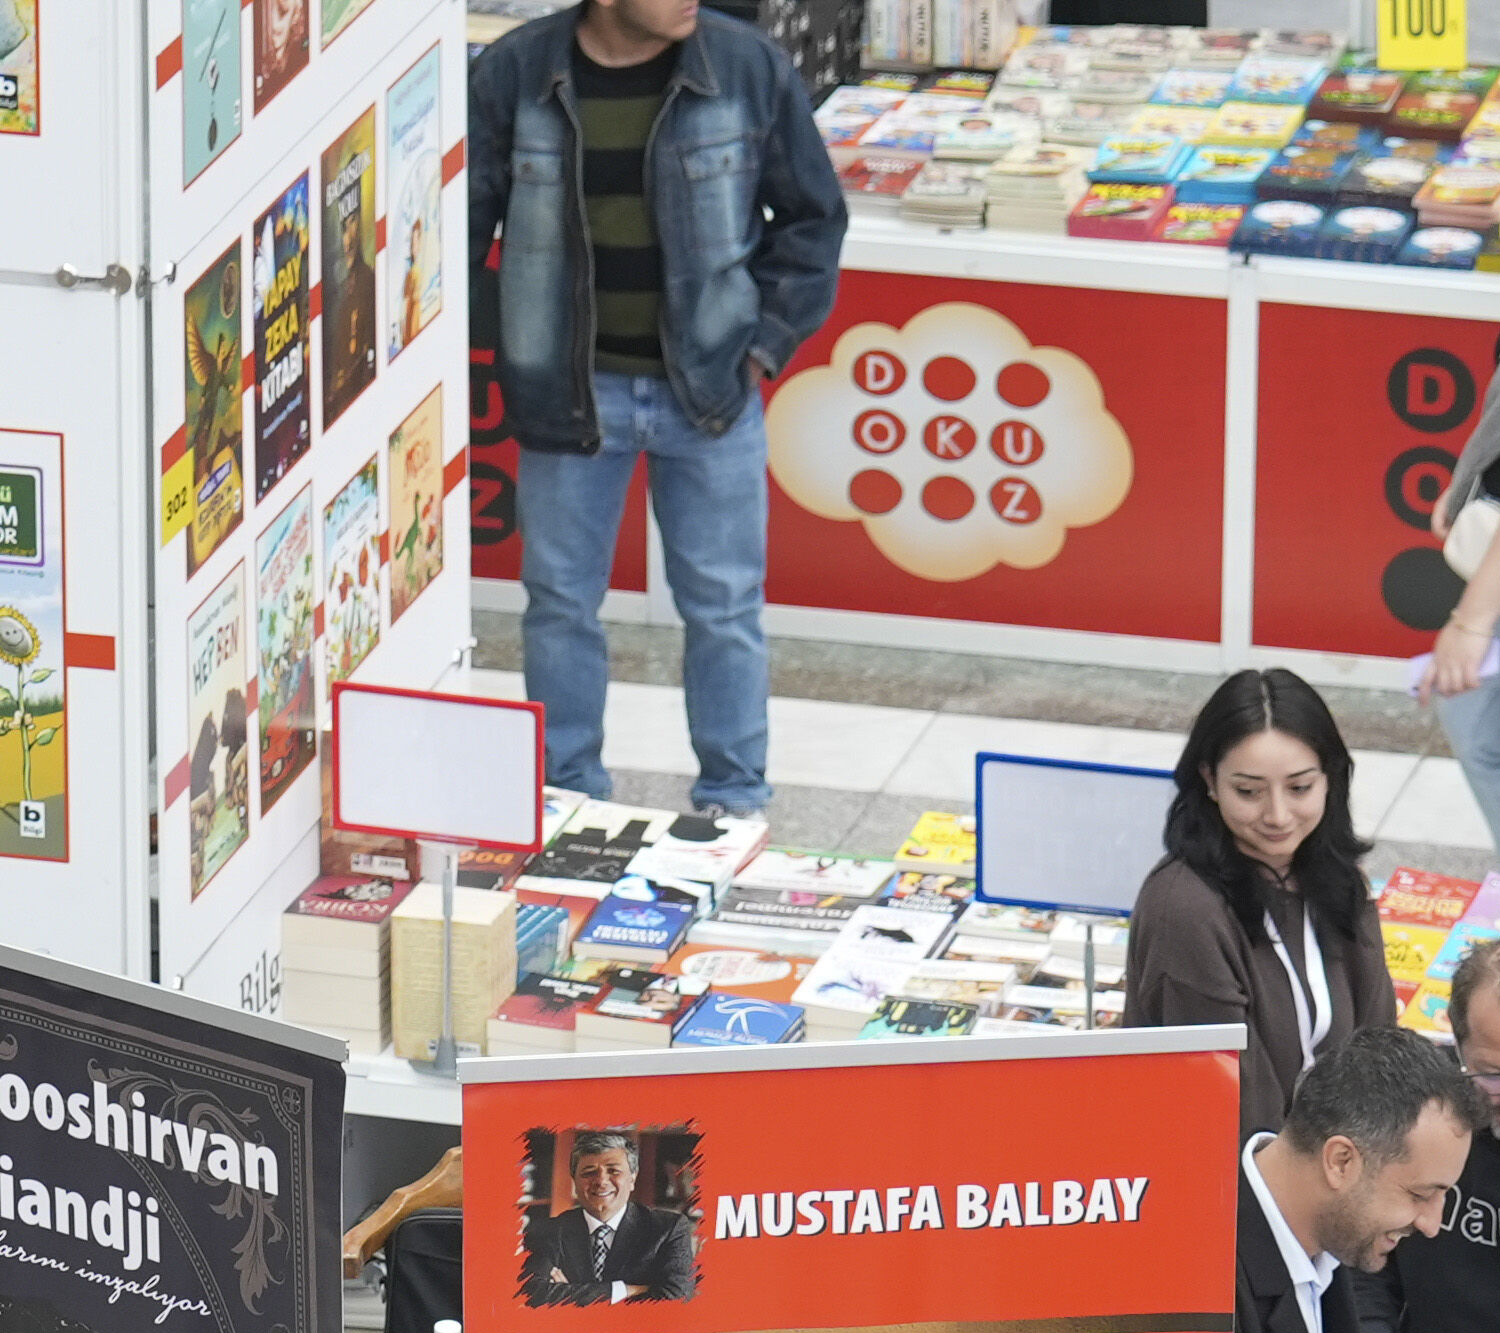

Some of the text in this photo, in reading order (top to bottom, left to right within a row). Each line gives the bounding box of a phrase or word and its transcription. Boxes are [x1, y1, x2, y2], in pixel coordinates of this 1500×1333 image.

[166, 487, 188, 521] 302
[239, 950, 280, 1015] Bilg
[714, 1177, 1149, 1240] MUSTAFA BALBAY
[75, 1256, 212, 1324] imzalıyor
